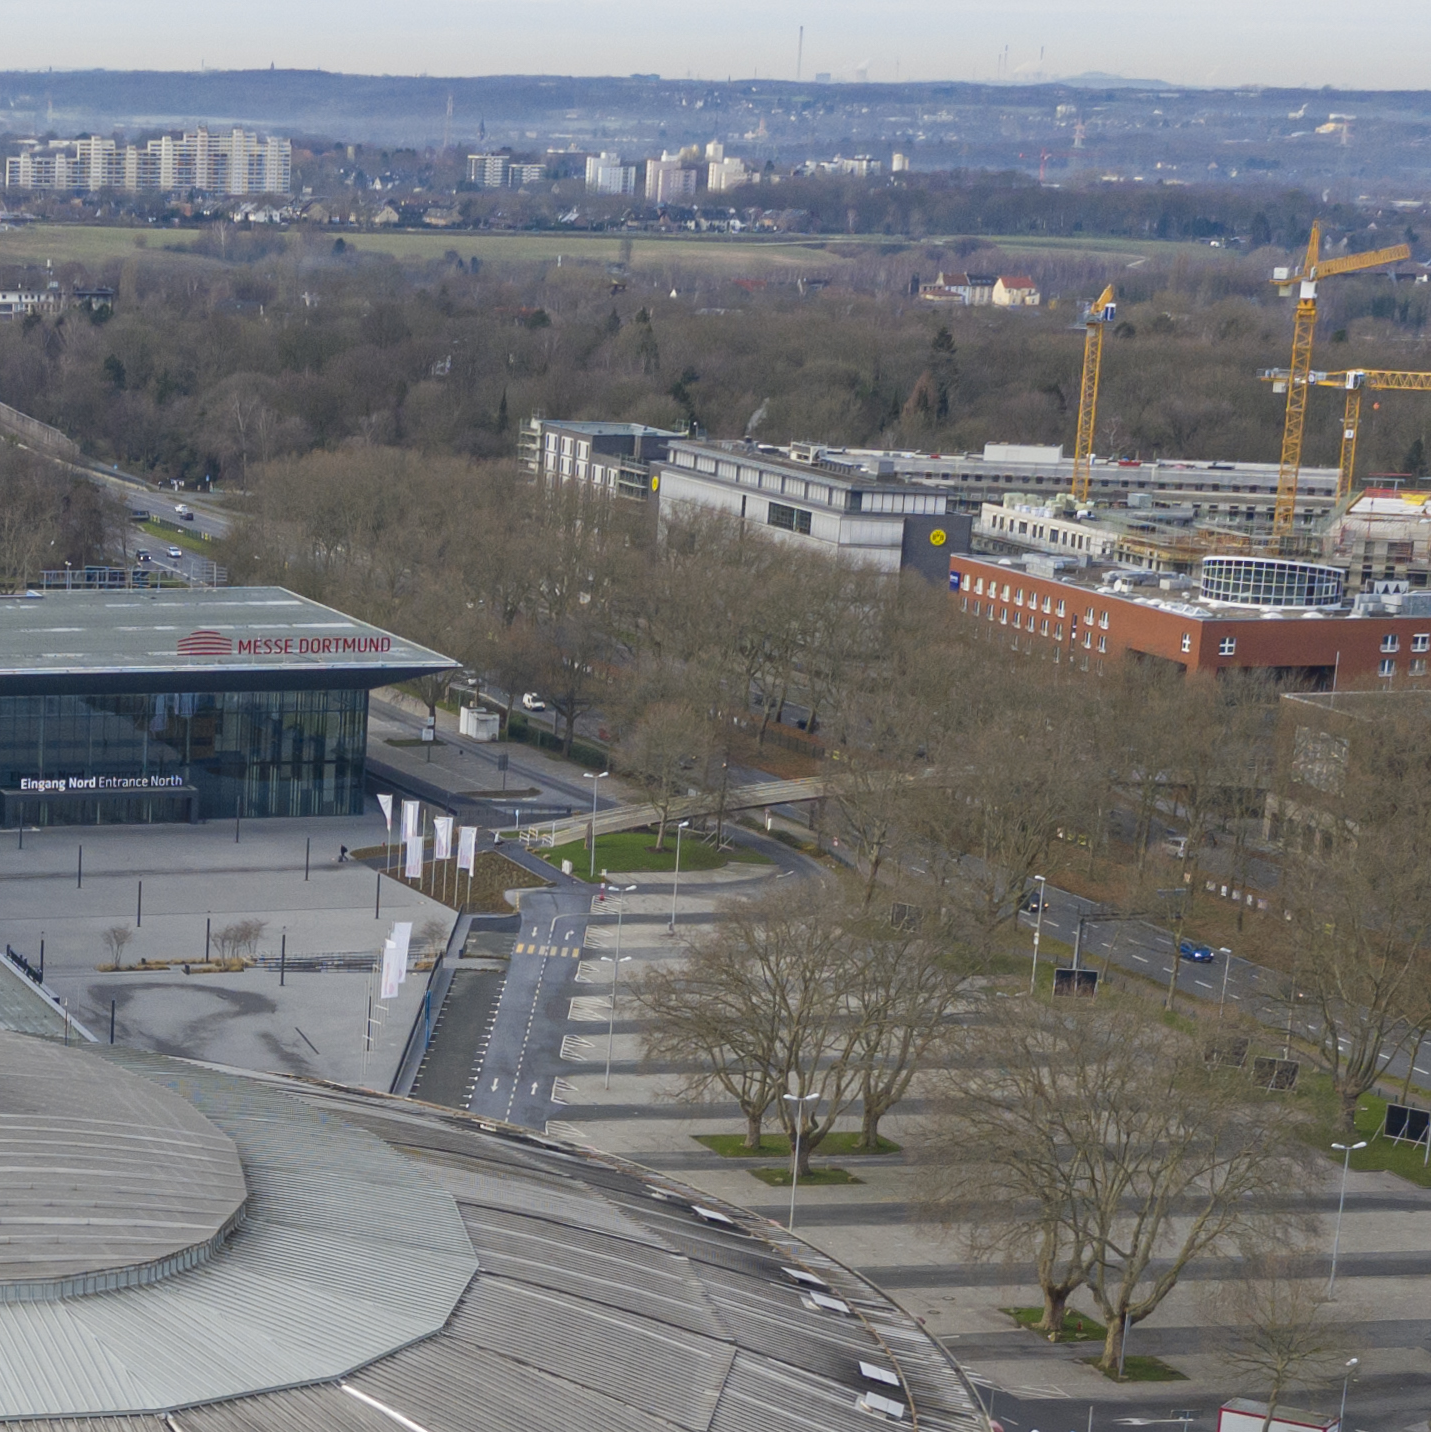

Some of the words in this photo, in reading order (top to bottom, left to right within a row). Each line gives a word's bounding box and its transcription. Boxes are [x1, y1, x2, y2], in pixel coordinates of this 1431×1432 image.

[238, 638, 293, 655] MESSE
[298, 637, 391, 654] DORTMUND
[20, 778, 66, 791] Eingang
[68, 777, 96, 788] Nord
[98, 776, 148, 787] Entrance
[150, 775, 183, 786] North
